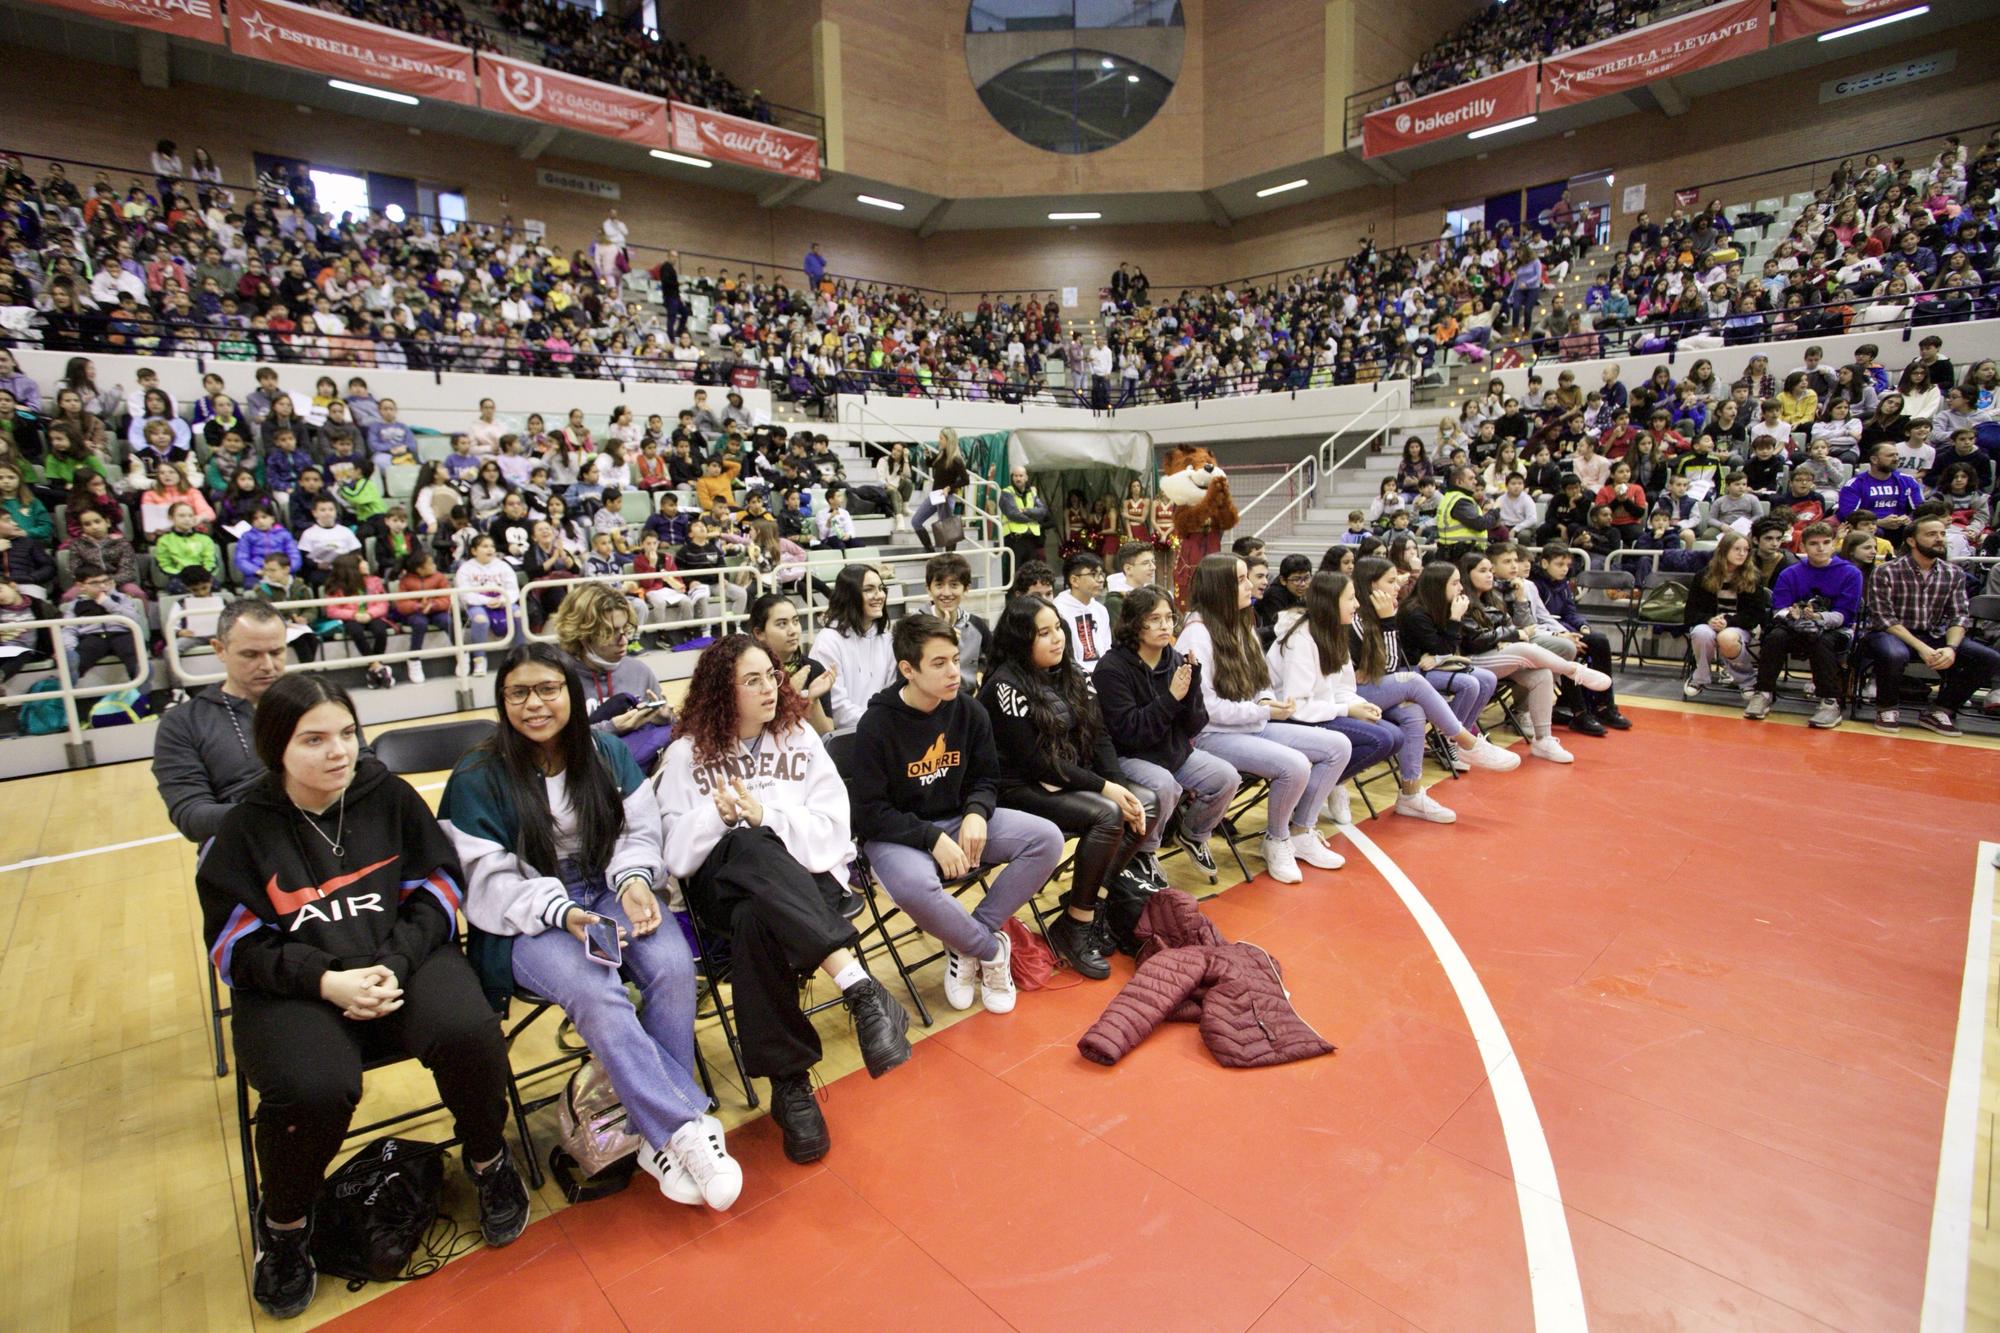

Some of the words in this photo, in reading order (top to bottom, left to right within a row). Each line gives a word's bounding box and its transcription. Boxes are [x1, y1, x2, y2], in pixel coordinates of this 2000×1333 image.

[278, 27, 375, 62] ESTRELLA
[391, 54, 466, 83] LEVANTE
[1576, 50, 1658, 82] ESTRELLA
[1674, 17, 1758, 53] LEVANTE
[1414, 98, 1496, 134] bakertilly
[909, 760, 932, 776] ON
[289, 892, 385, 932] AIR
